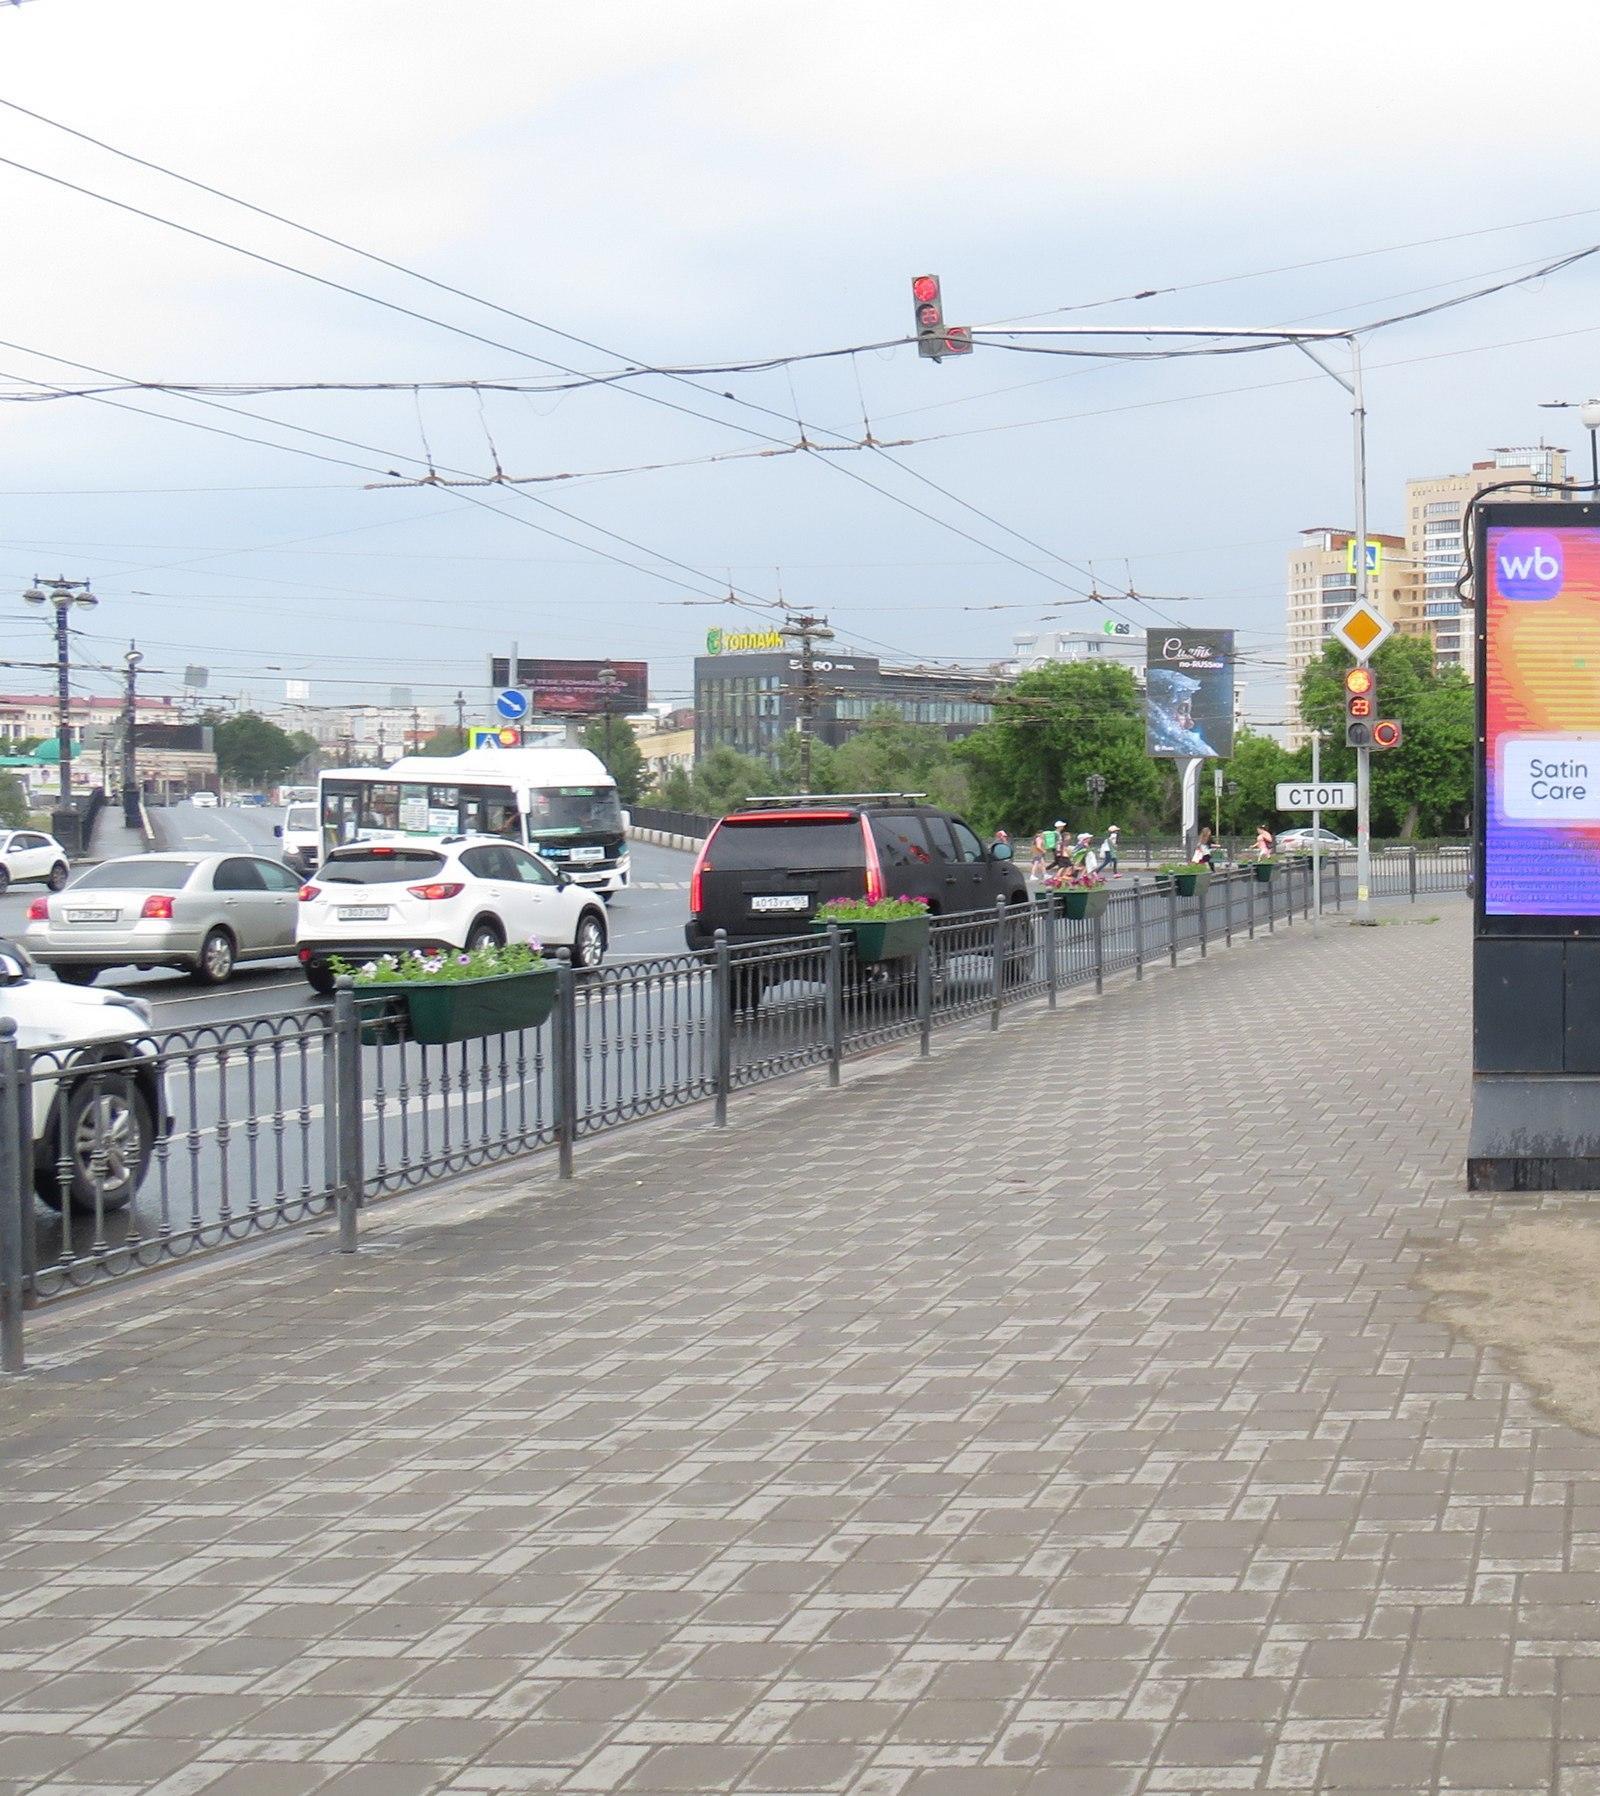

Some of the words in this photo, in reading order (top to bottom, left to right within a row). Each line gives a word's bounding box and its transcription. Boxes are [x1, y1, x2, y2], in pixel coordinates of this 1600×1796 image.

[1499, 547, 1560, 581] wb
[1529, 758, 1588, 778] Satin
[1289, 788, 1344, 805] СТОП
[1530, 780, 1587, 800] Care
